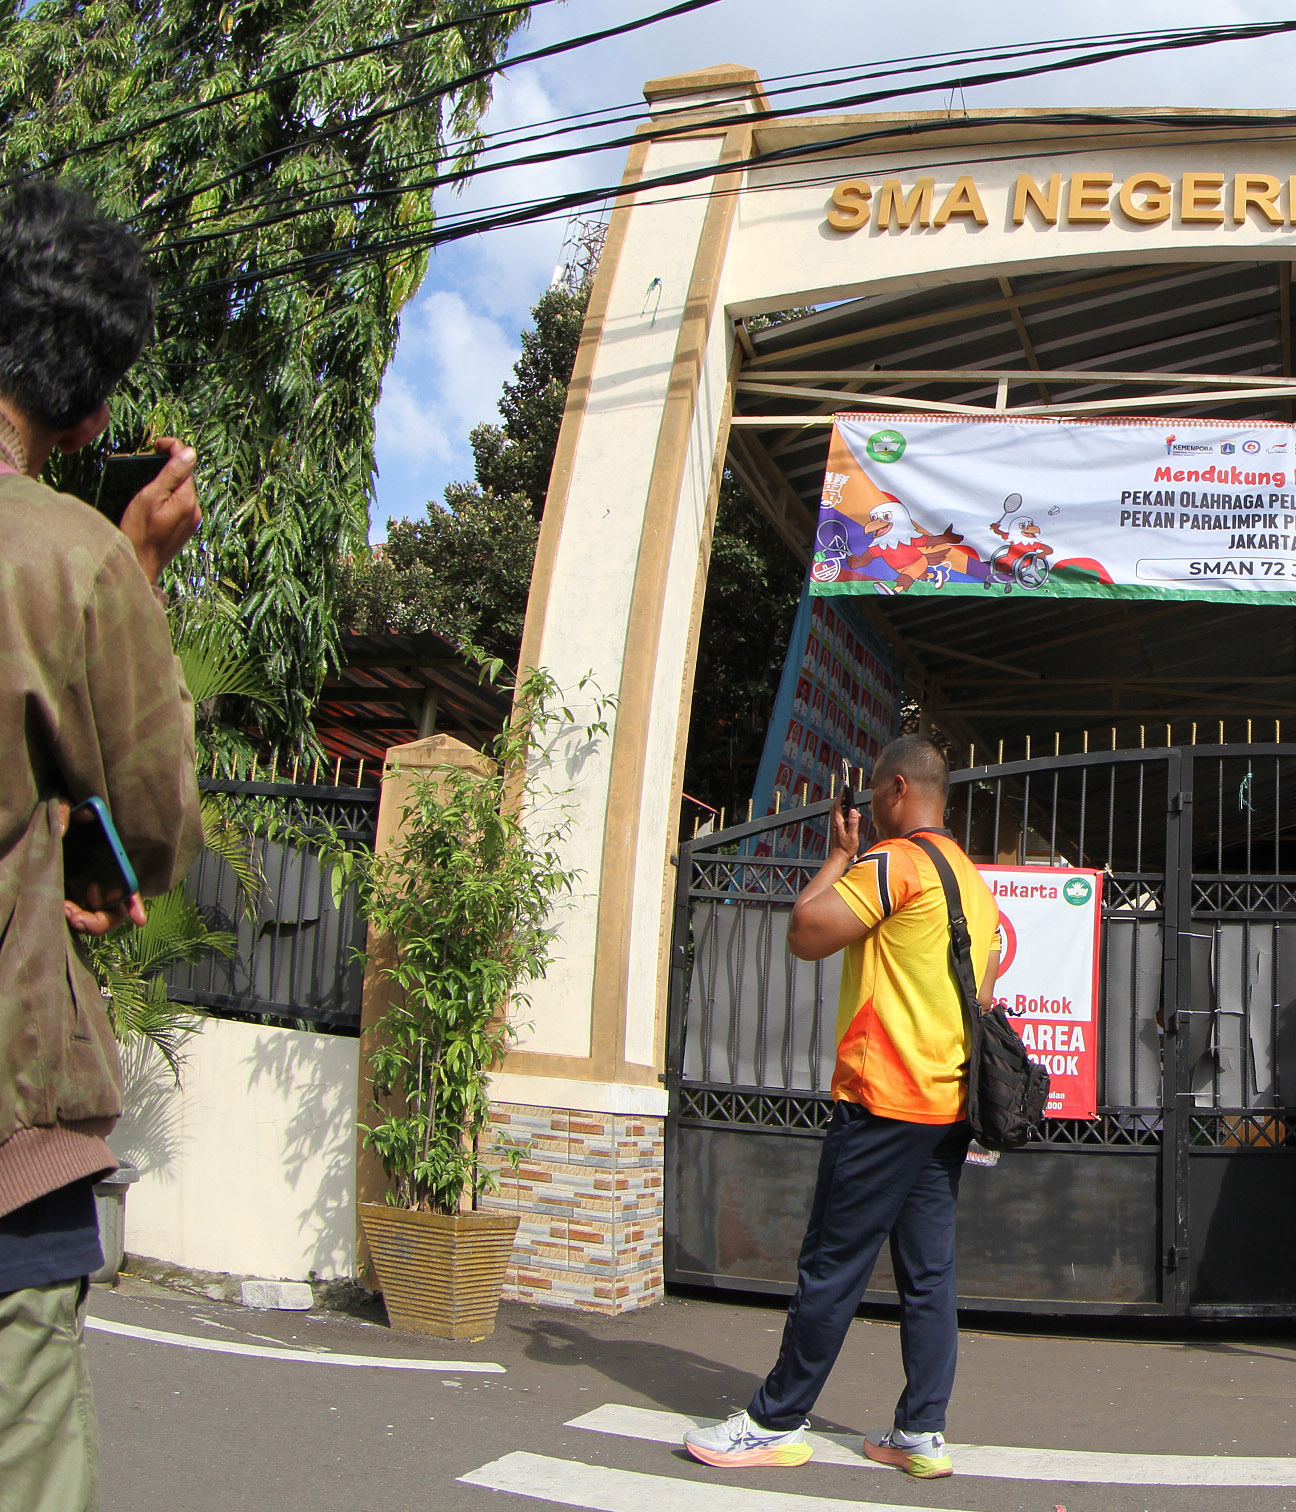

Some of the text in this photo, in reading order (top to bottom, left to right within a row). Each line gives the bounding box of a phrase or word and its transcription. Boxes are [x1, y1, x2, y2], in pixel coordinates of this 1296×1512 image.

[827, 176, 988, 231] SMA
[1154, 466, 1286, 488] Mendukung
[1121, 491, 1175, 506] PEKAN
[1180, 491, 1264, 510] OLAHRAGA
[1120, 511, 1174, 528] PEKAN
[1179, 513, 1278, 530] PARALIMPIK
[1189, 561, 1253, 575] SMAN
[1261, 562, 1285, 576] 72
[992, 880, 1058, 899] Jakarta
[1015, 994, 1072, 1014] Rokok
[1022, 1023, 1086, 1052] AREA
[1047, 1091, 1065, 1099] ulan
